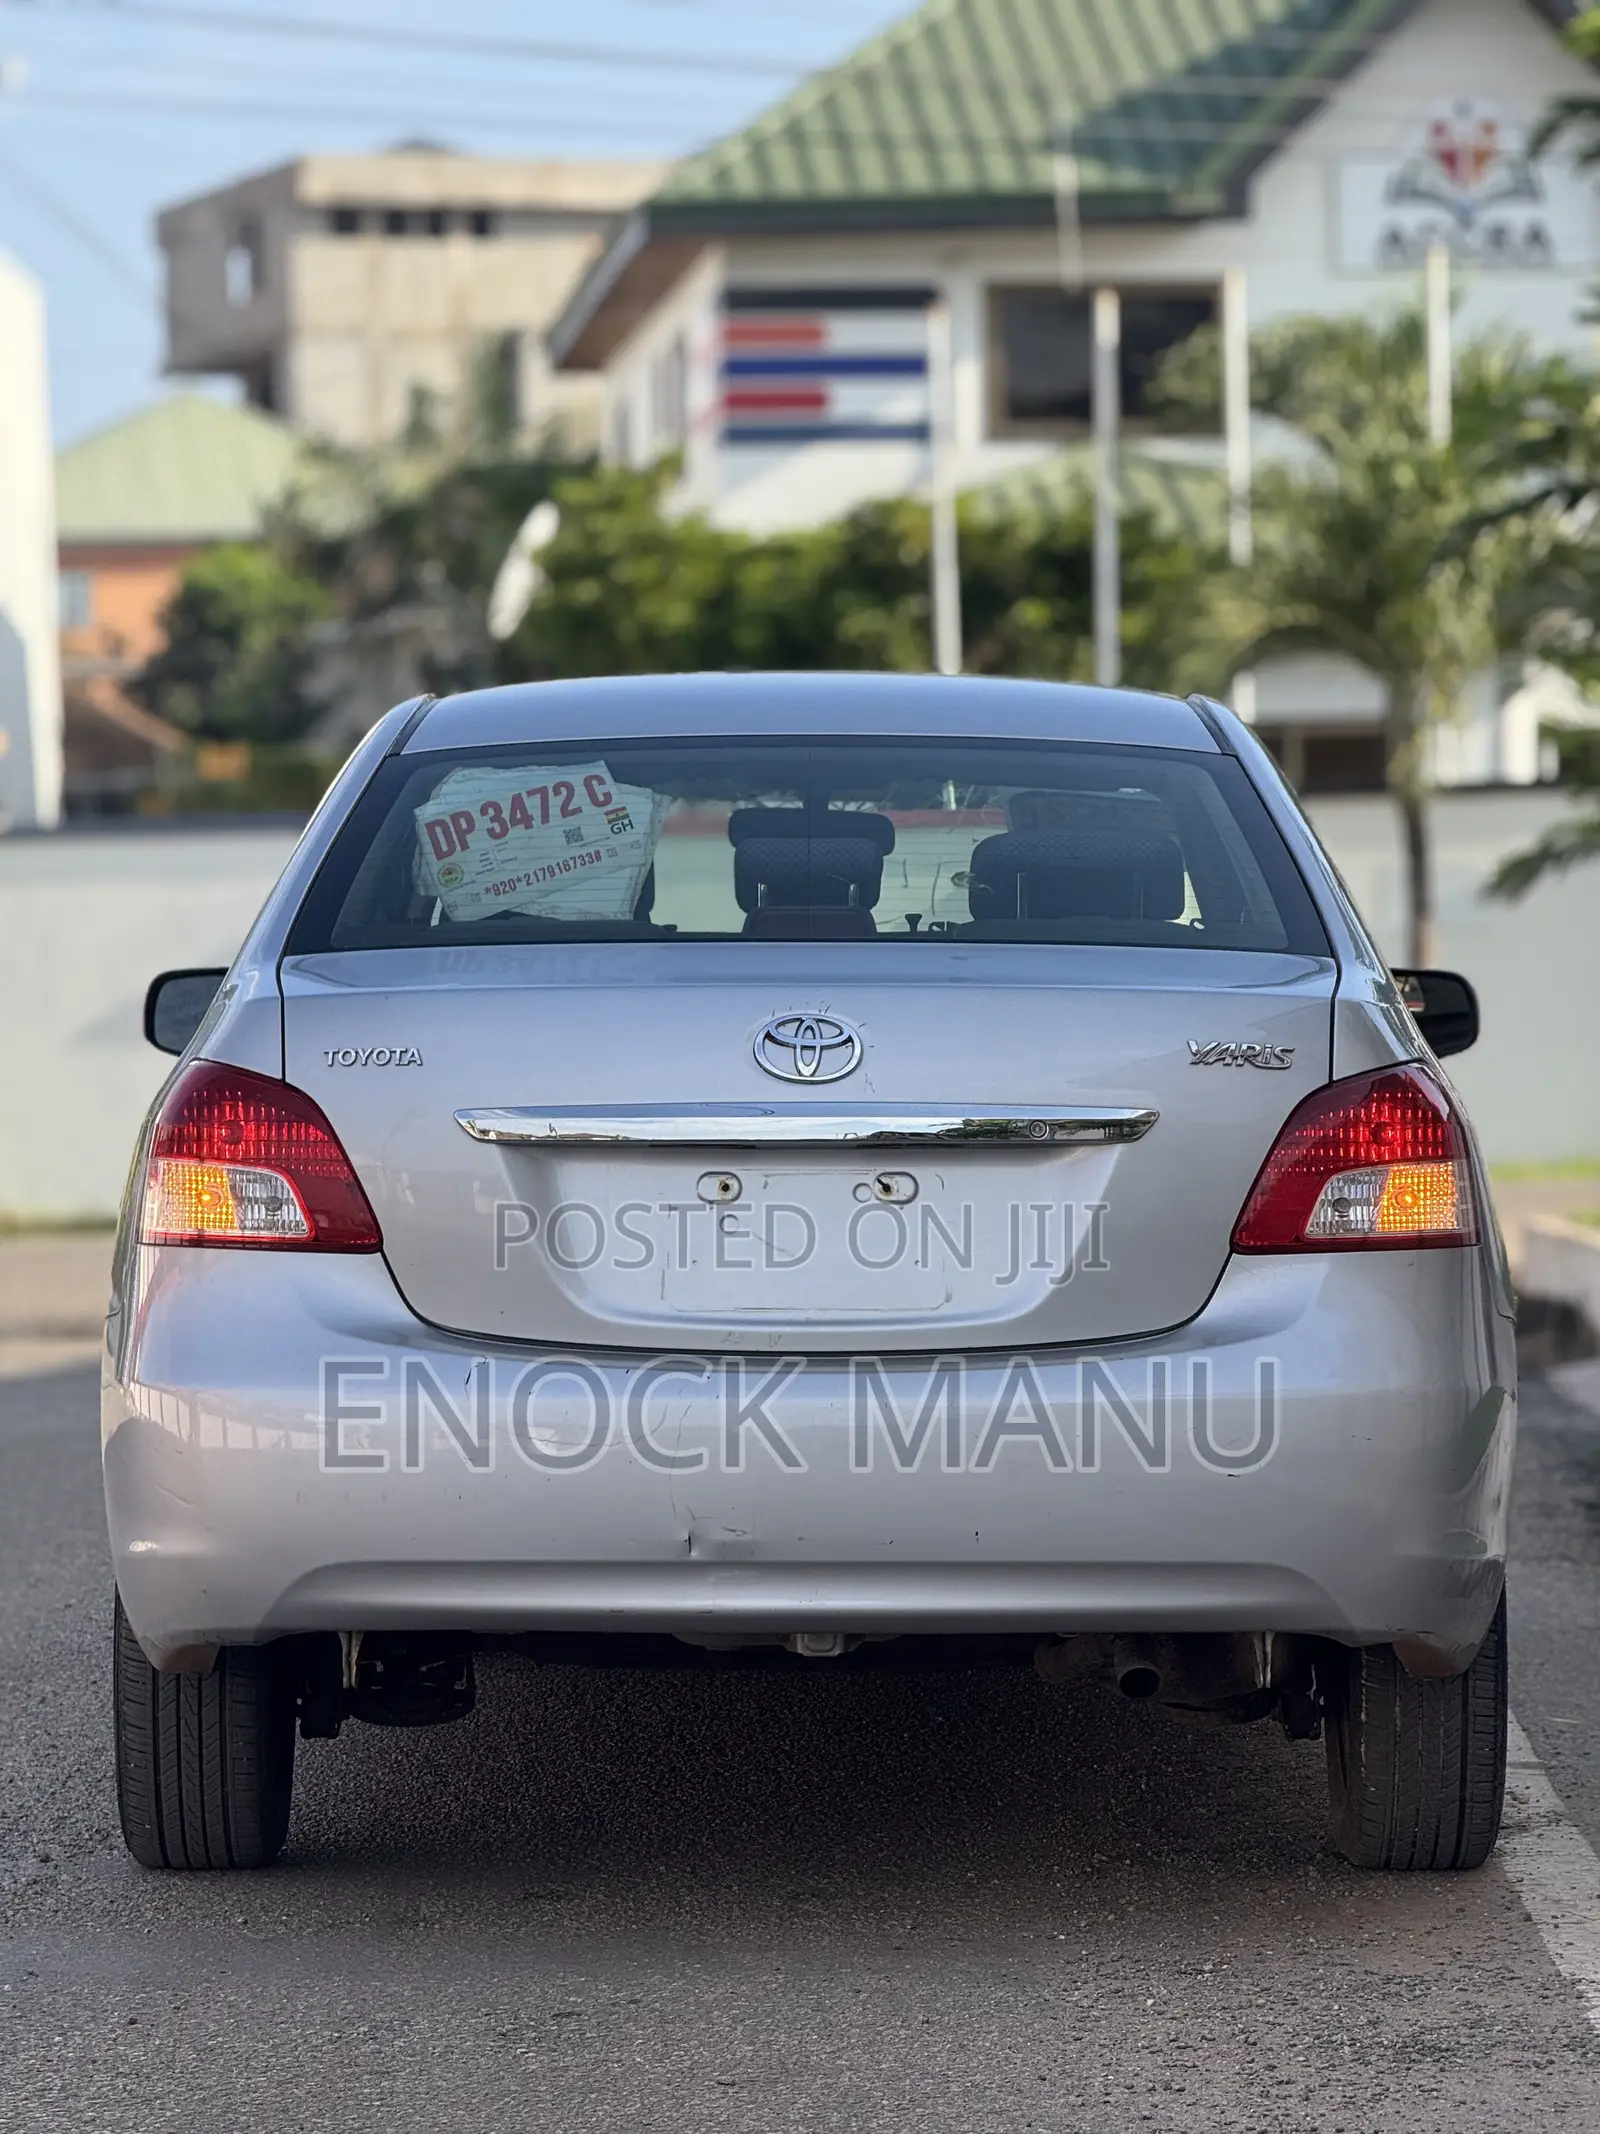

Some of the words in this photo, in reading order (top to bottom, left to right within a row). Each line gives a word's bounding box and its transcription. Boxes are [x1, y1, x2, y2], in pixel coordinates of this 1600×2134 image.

[425, 810, 476, 861] DP
[480, 780, 583, 840] 3472
[583, 774, 613, 808] C
[610, 819, 635, 835] GH
[324, 1047, 423, 1067] TOYOTA
